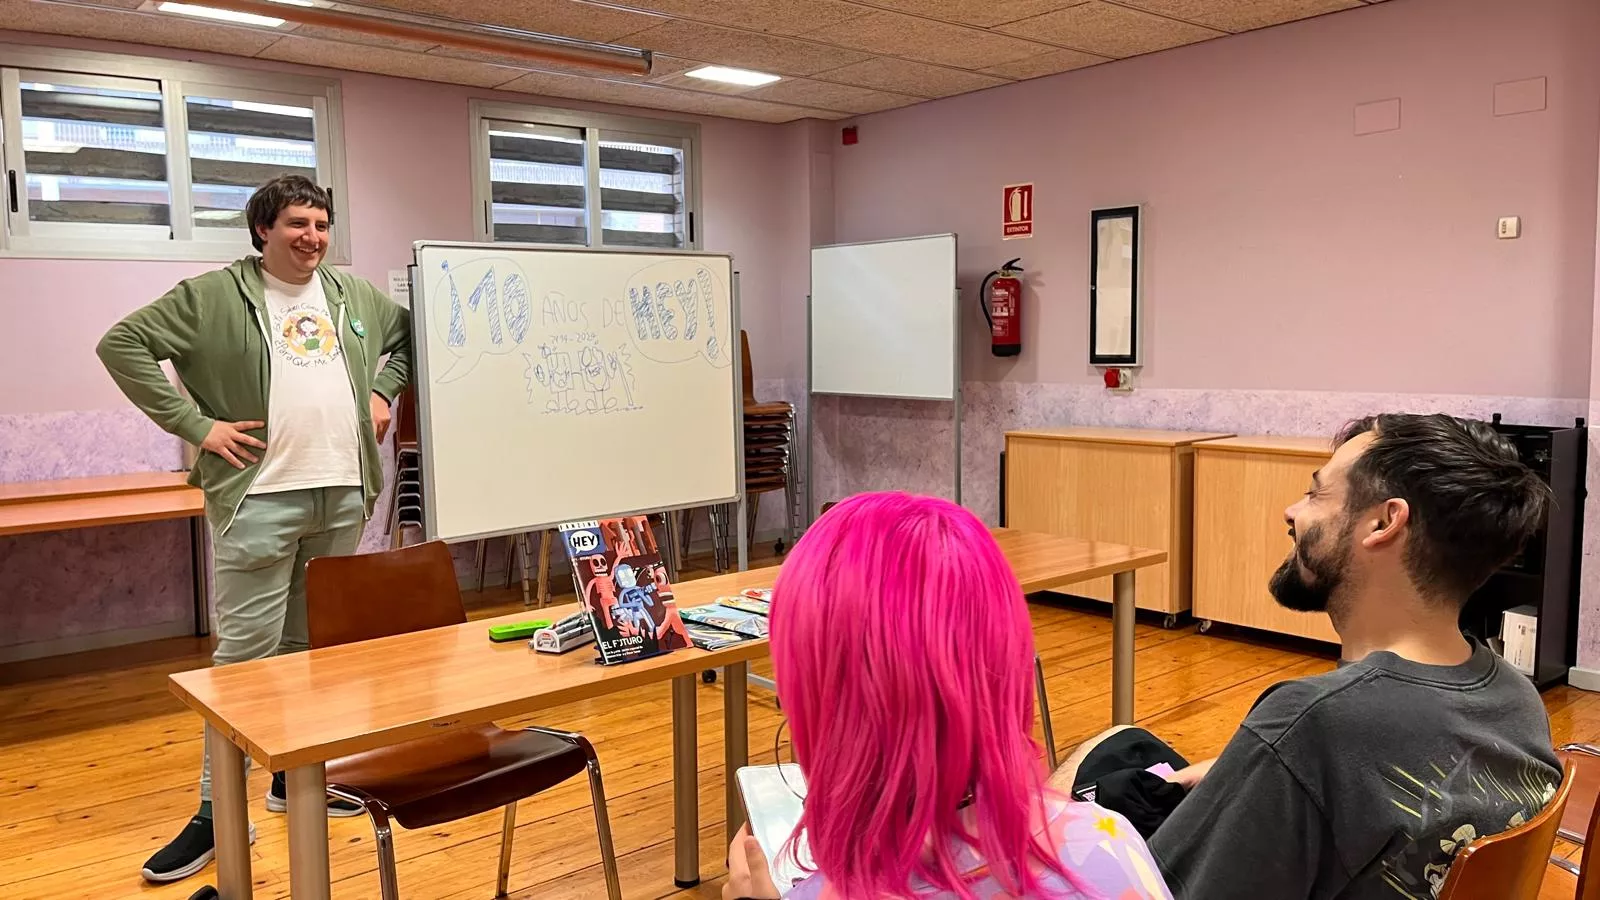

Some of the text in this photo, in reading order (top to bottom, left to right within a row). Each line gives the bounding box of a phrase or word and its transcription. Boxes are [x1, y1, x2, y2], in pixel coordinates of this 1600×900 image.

[1006, 224, 1029, 233] EXTINTOR
[541, 291, 588, 329] AÑOS
[602, 297, 626, 328] DE
[629, 268, 719, 362] HEY!
[559, 521, 598, 530] FANZINE
[602, 641, 613, 650] EL
